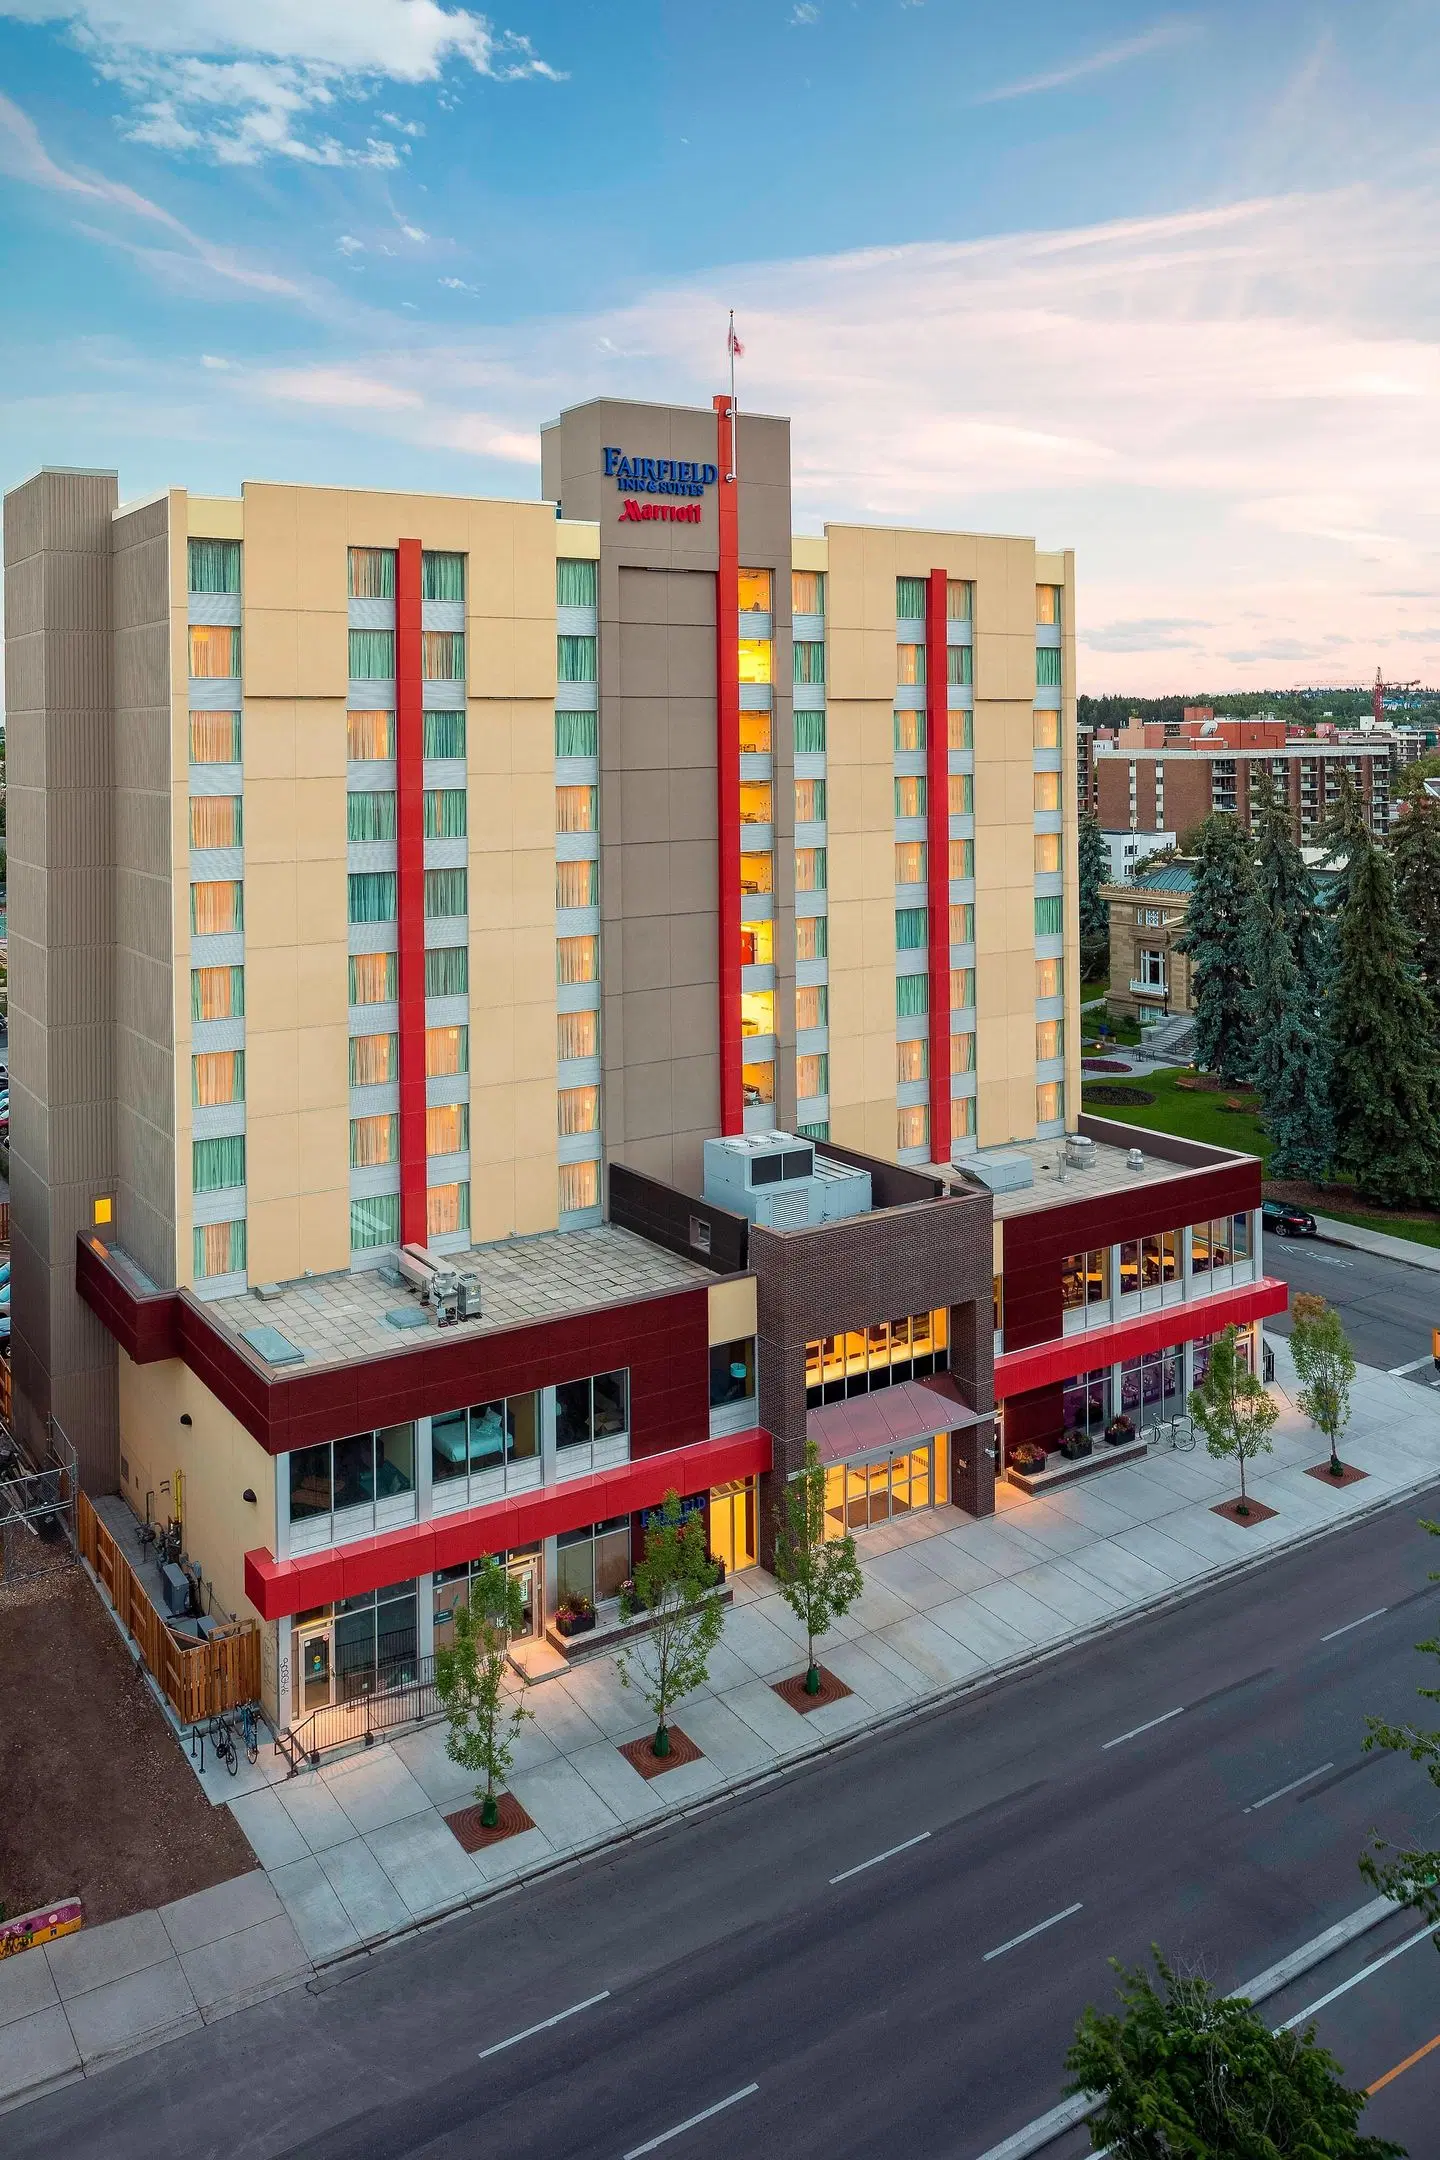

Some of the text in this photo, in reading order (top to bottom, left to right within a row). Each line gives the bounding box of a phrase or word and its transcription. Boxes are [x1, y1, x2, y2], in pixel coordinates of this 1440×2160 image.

[618, 477, 704, 496] INN & SUITES
[618, 499, 702, 523] Marriott
